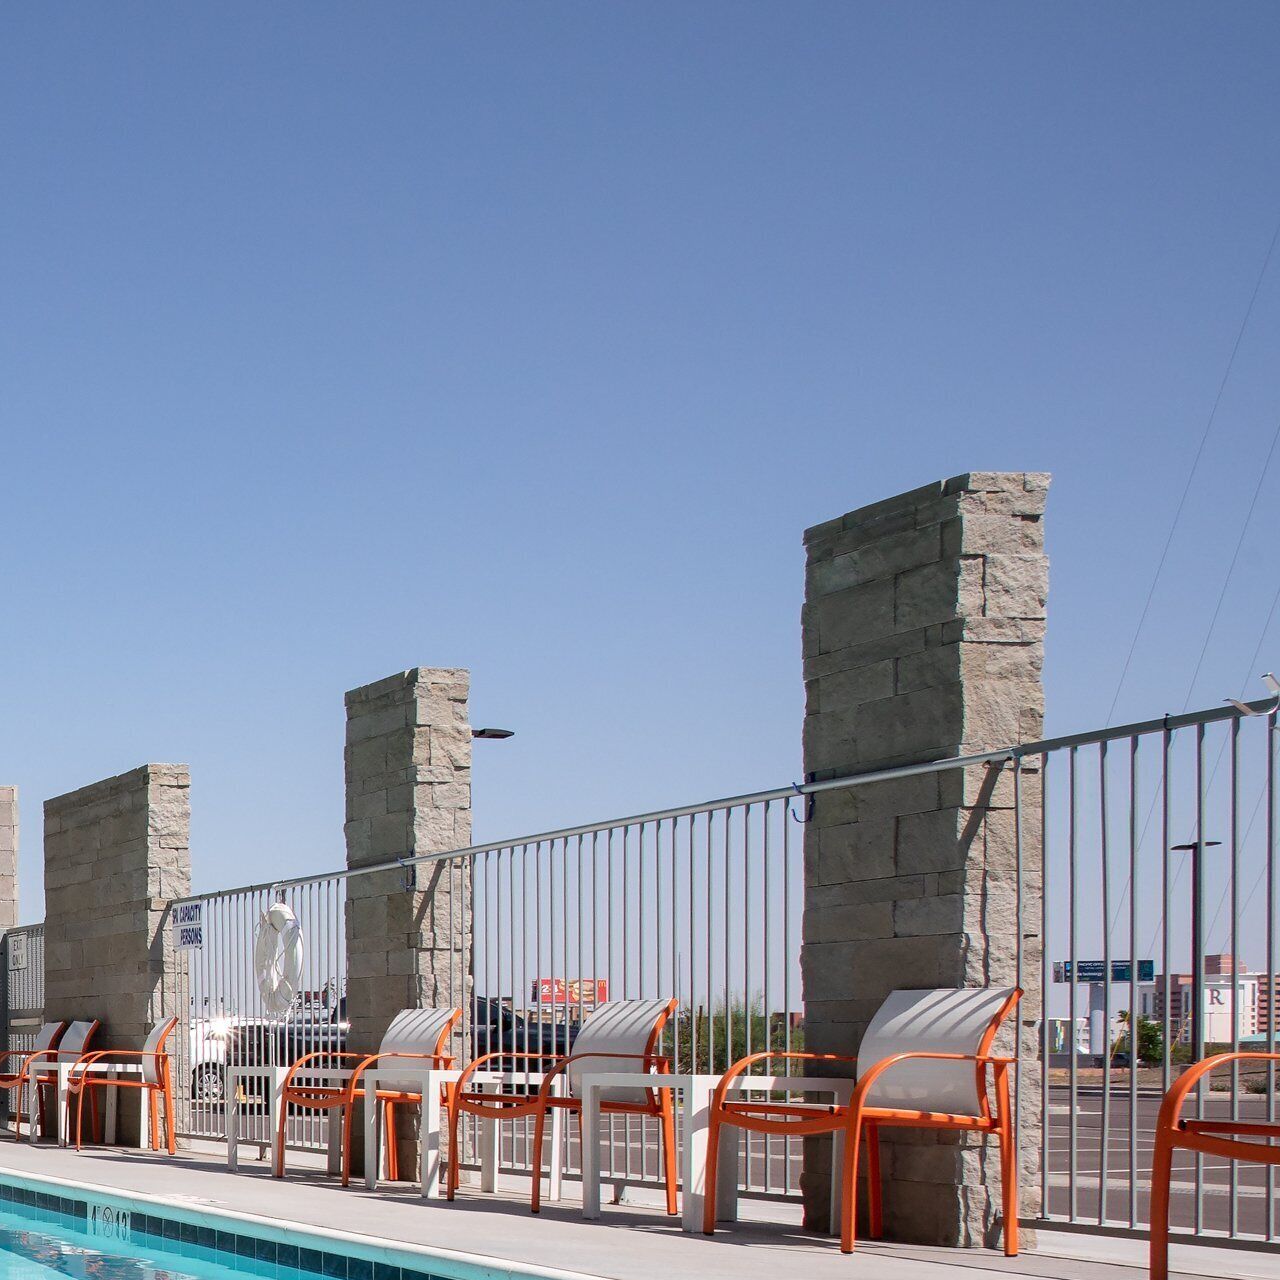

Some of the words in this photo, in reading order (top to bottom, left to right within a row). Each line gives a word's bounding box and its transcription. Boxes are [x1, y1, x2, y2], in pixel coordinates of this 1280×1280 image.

[180, 904, 201, 922] CAPACITY
[181, 927, 203, 945] PERSONS
[1209, 989, 1224, 1005] R
